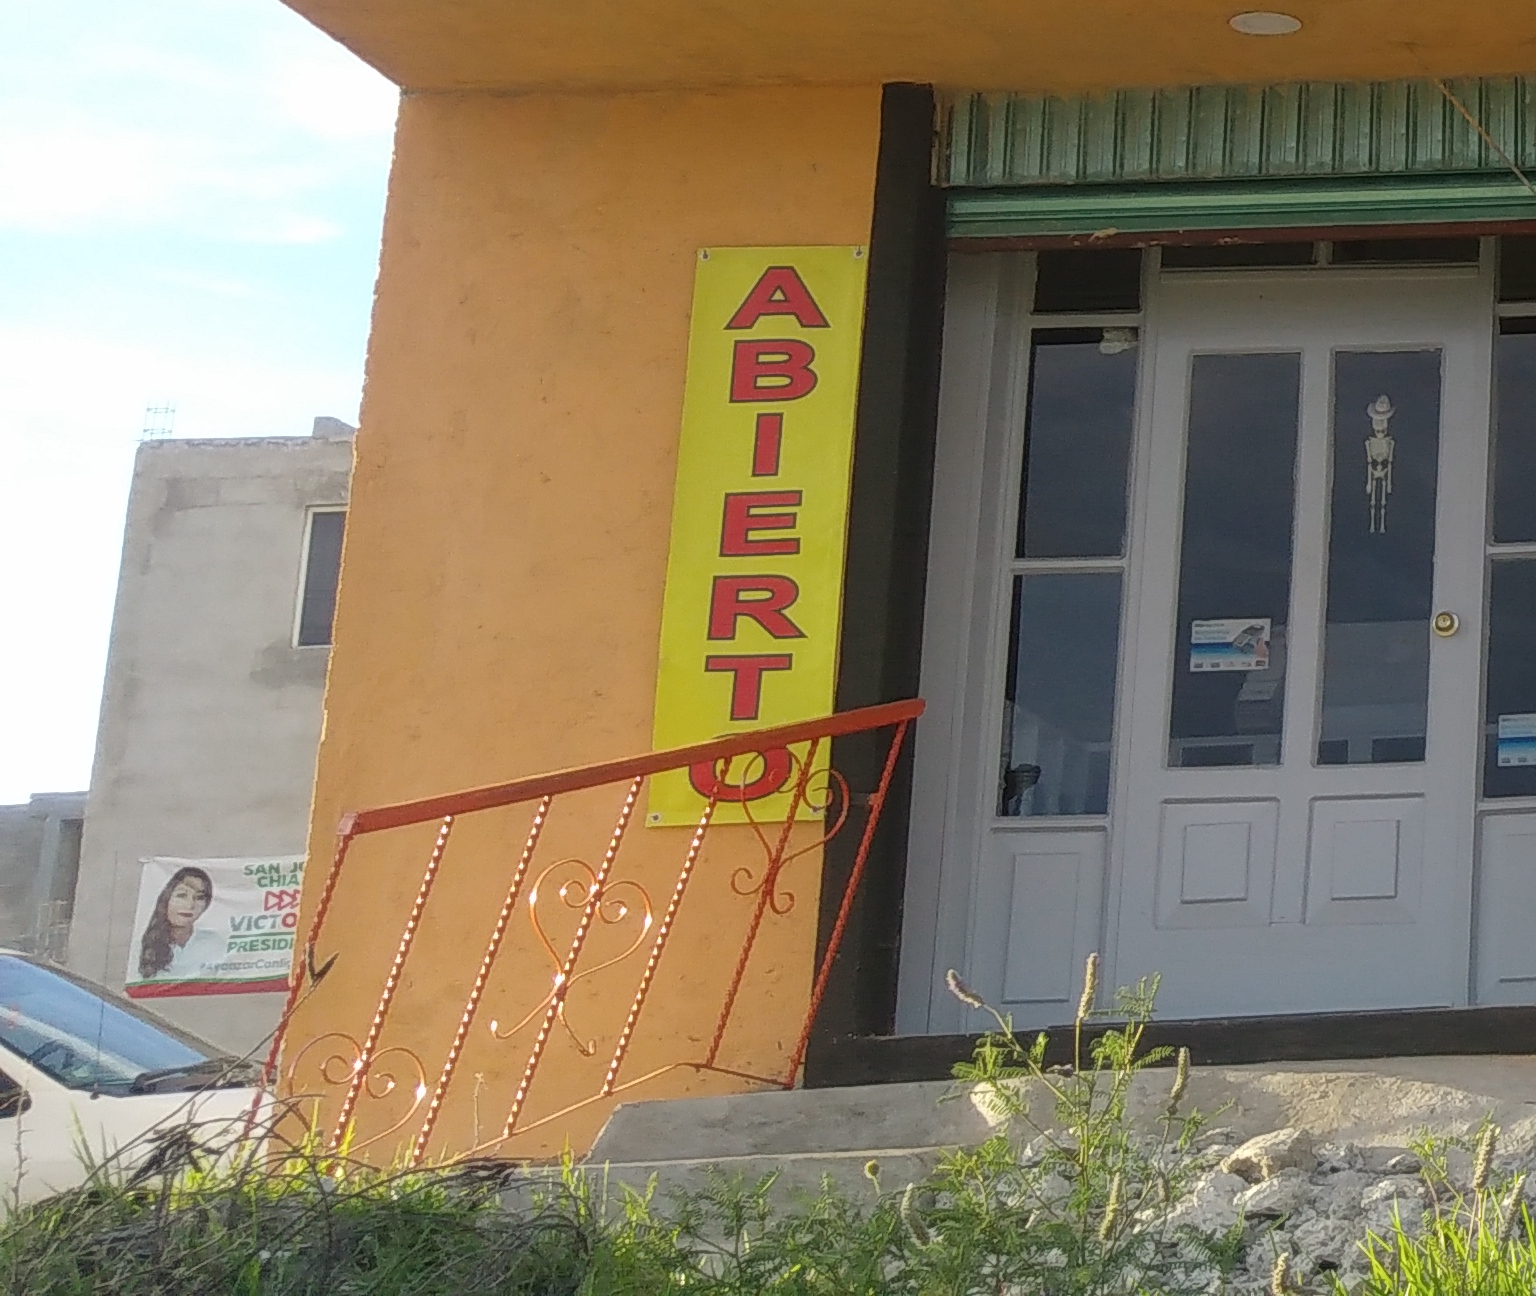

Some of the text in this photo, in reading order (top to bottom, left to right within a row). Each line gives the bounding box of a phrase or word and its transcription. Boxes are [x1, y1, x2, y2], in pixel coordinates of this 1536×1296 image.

[688, 265, 830, 803] ABIERTO
[243, 862, 281, 877] SAN
[257, 873, 300, 889] CHIA
[230, 912, 298, 932] VICTO
